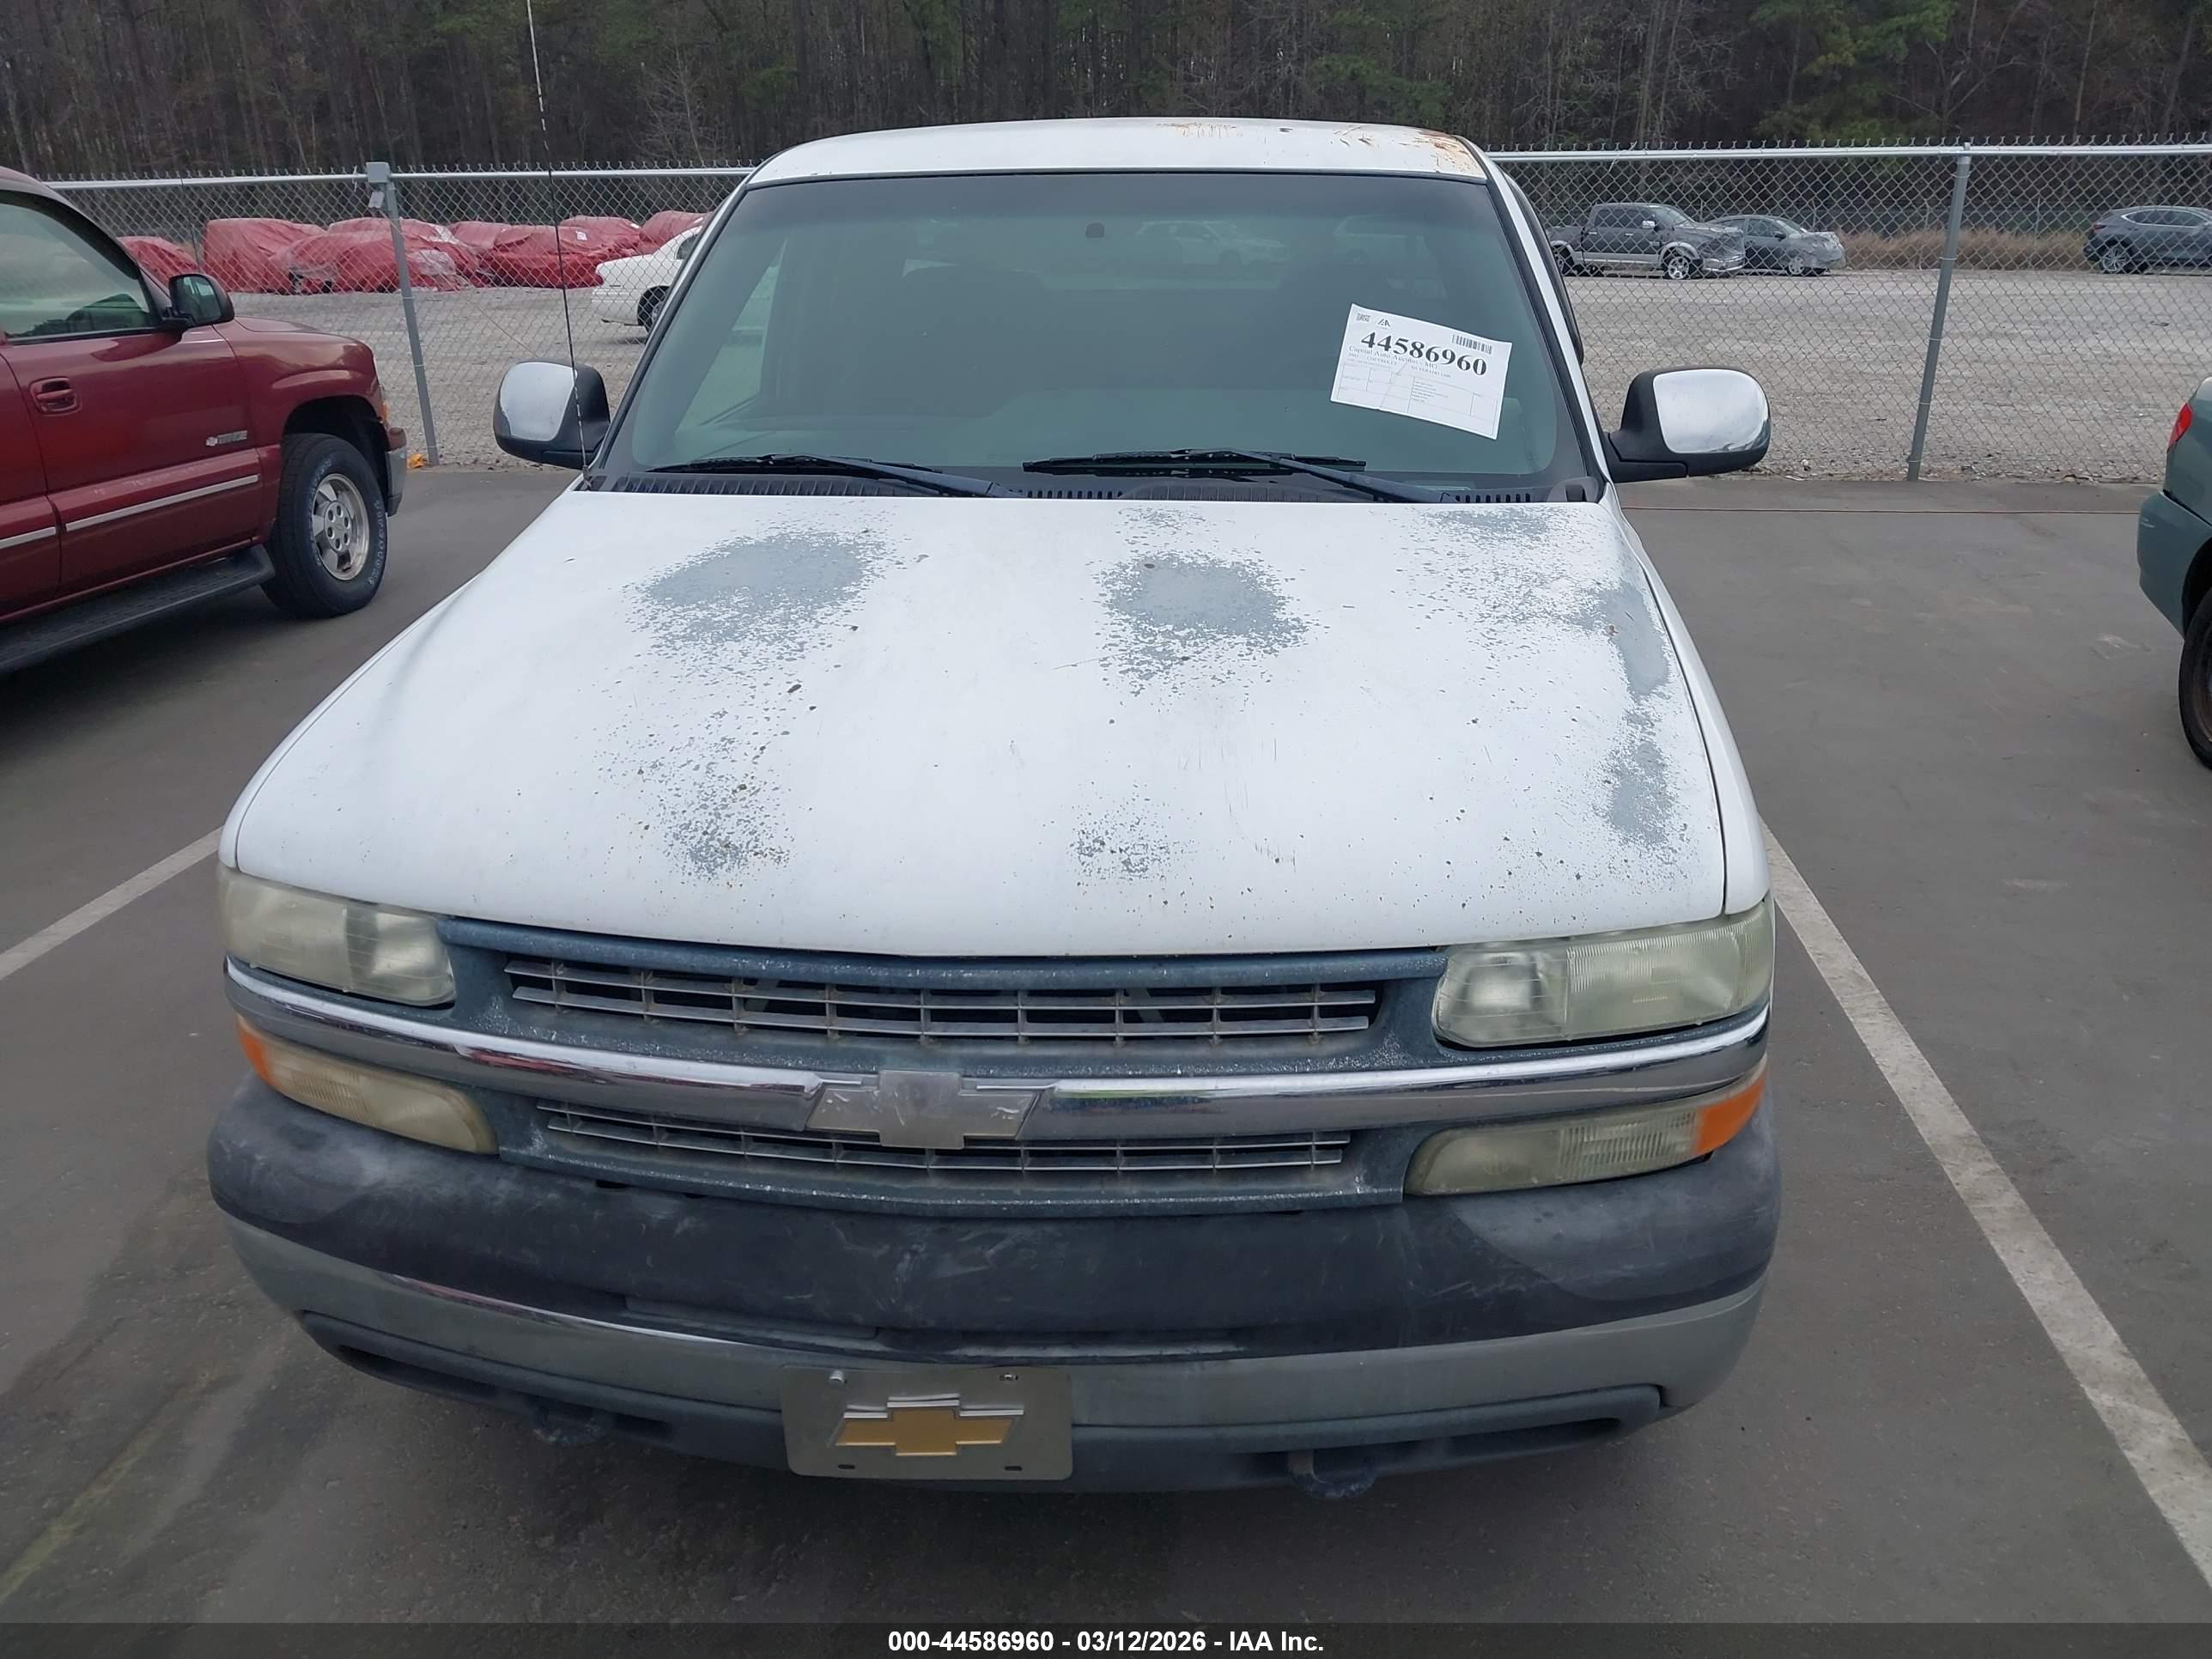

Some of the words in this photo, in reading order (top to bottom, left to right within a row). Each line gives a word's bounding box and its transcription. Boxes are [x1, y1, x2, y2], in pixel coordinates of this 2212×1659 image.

[1349, 345, 1374, 355] Capital
[1375, 350, 1392, 359] Auto
[1360, 331, 1487, 376] 44586960
